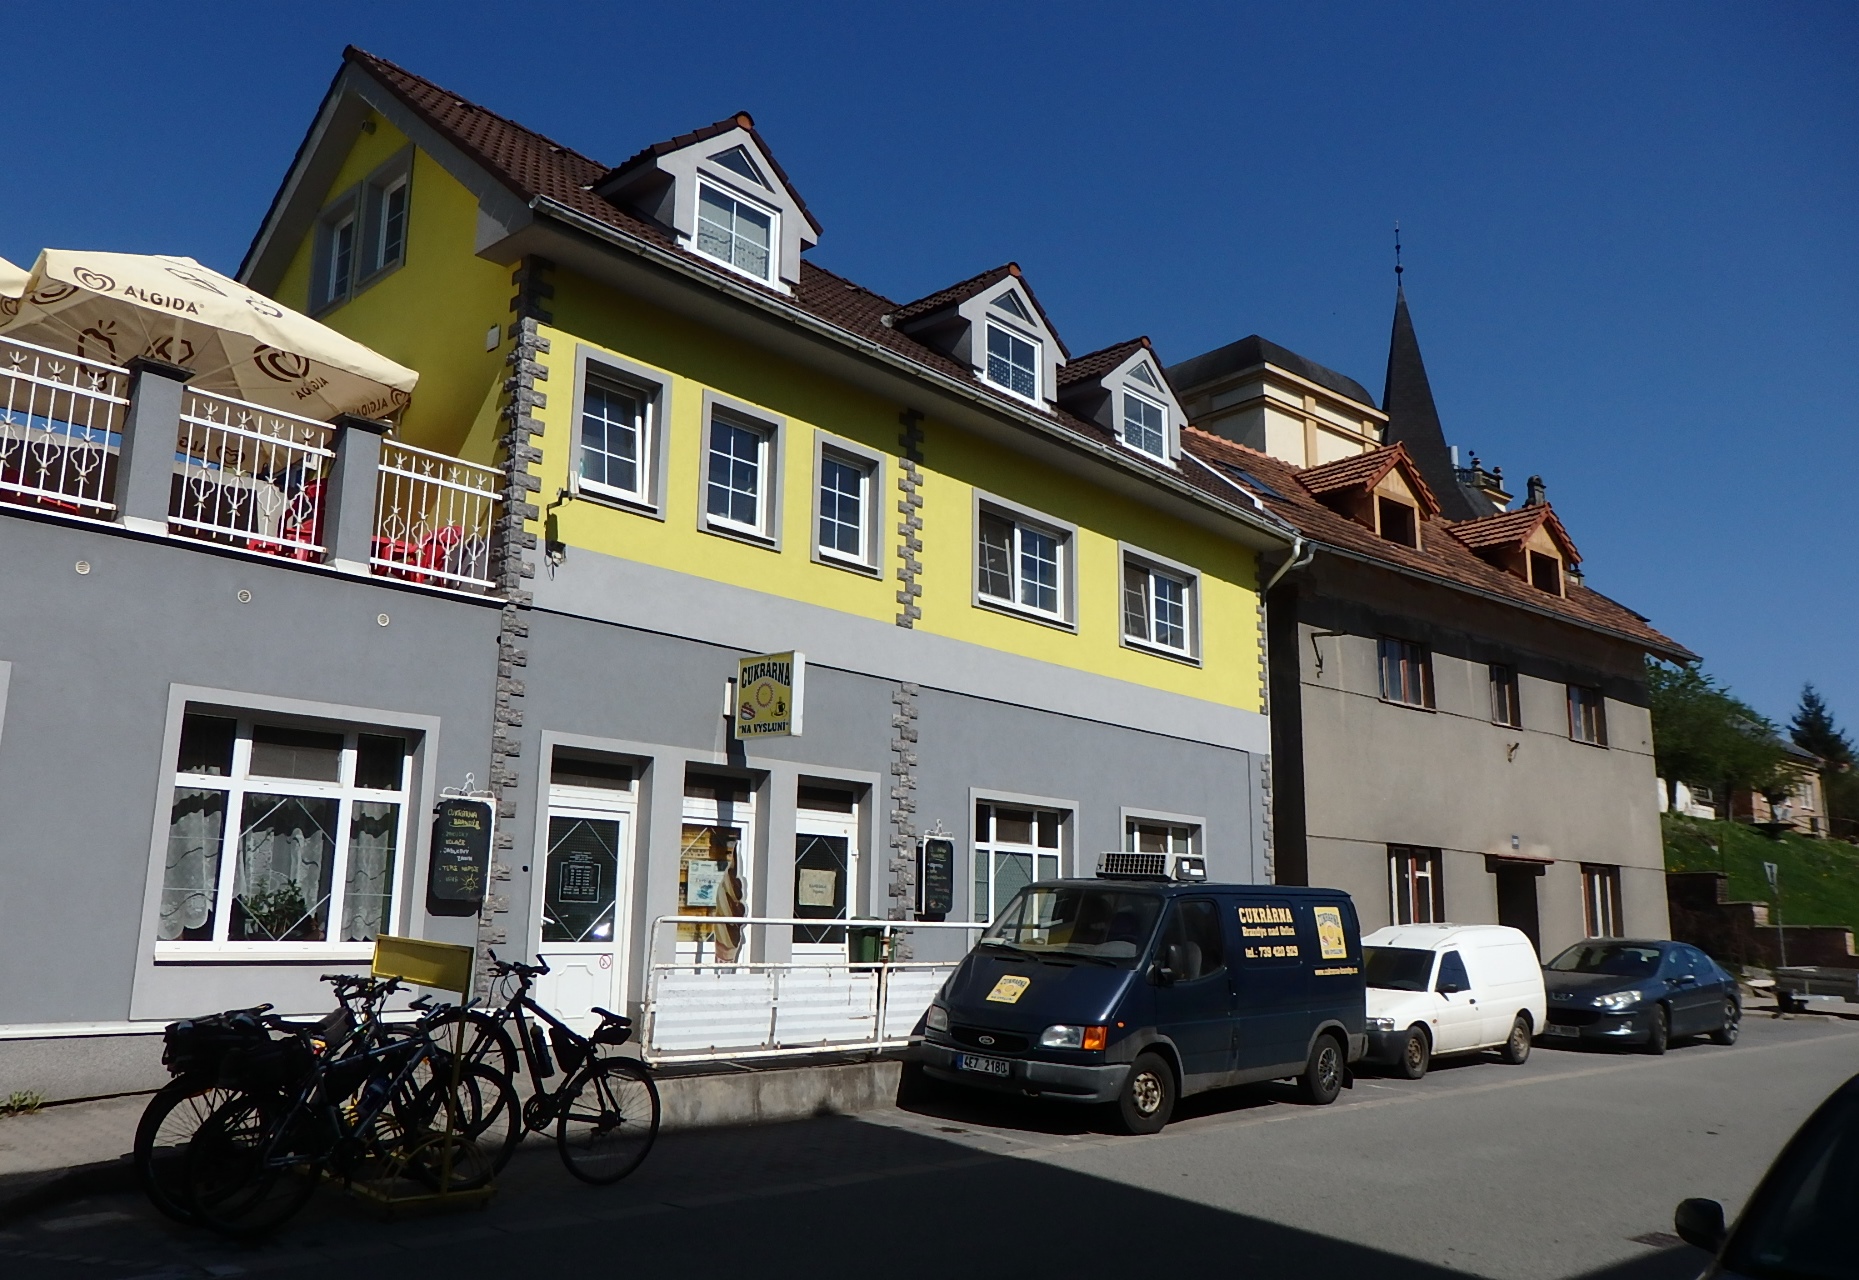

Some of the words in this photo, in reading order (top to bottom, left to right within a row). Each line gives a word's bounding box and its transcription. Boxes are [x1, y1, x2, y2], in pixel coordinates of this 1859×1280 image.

[124, 285, 199, 315] ALGIDA
[741, 657, 791, 689] CUKRÁRNA
[1238, 905, 1293, 924] CUKRÁRNA
[964, 1055, 980, 1069] 4E7
